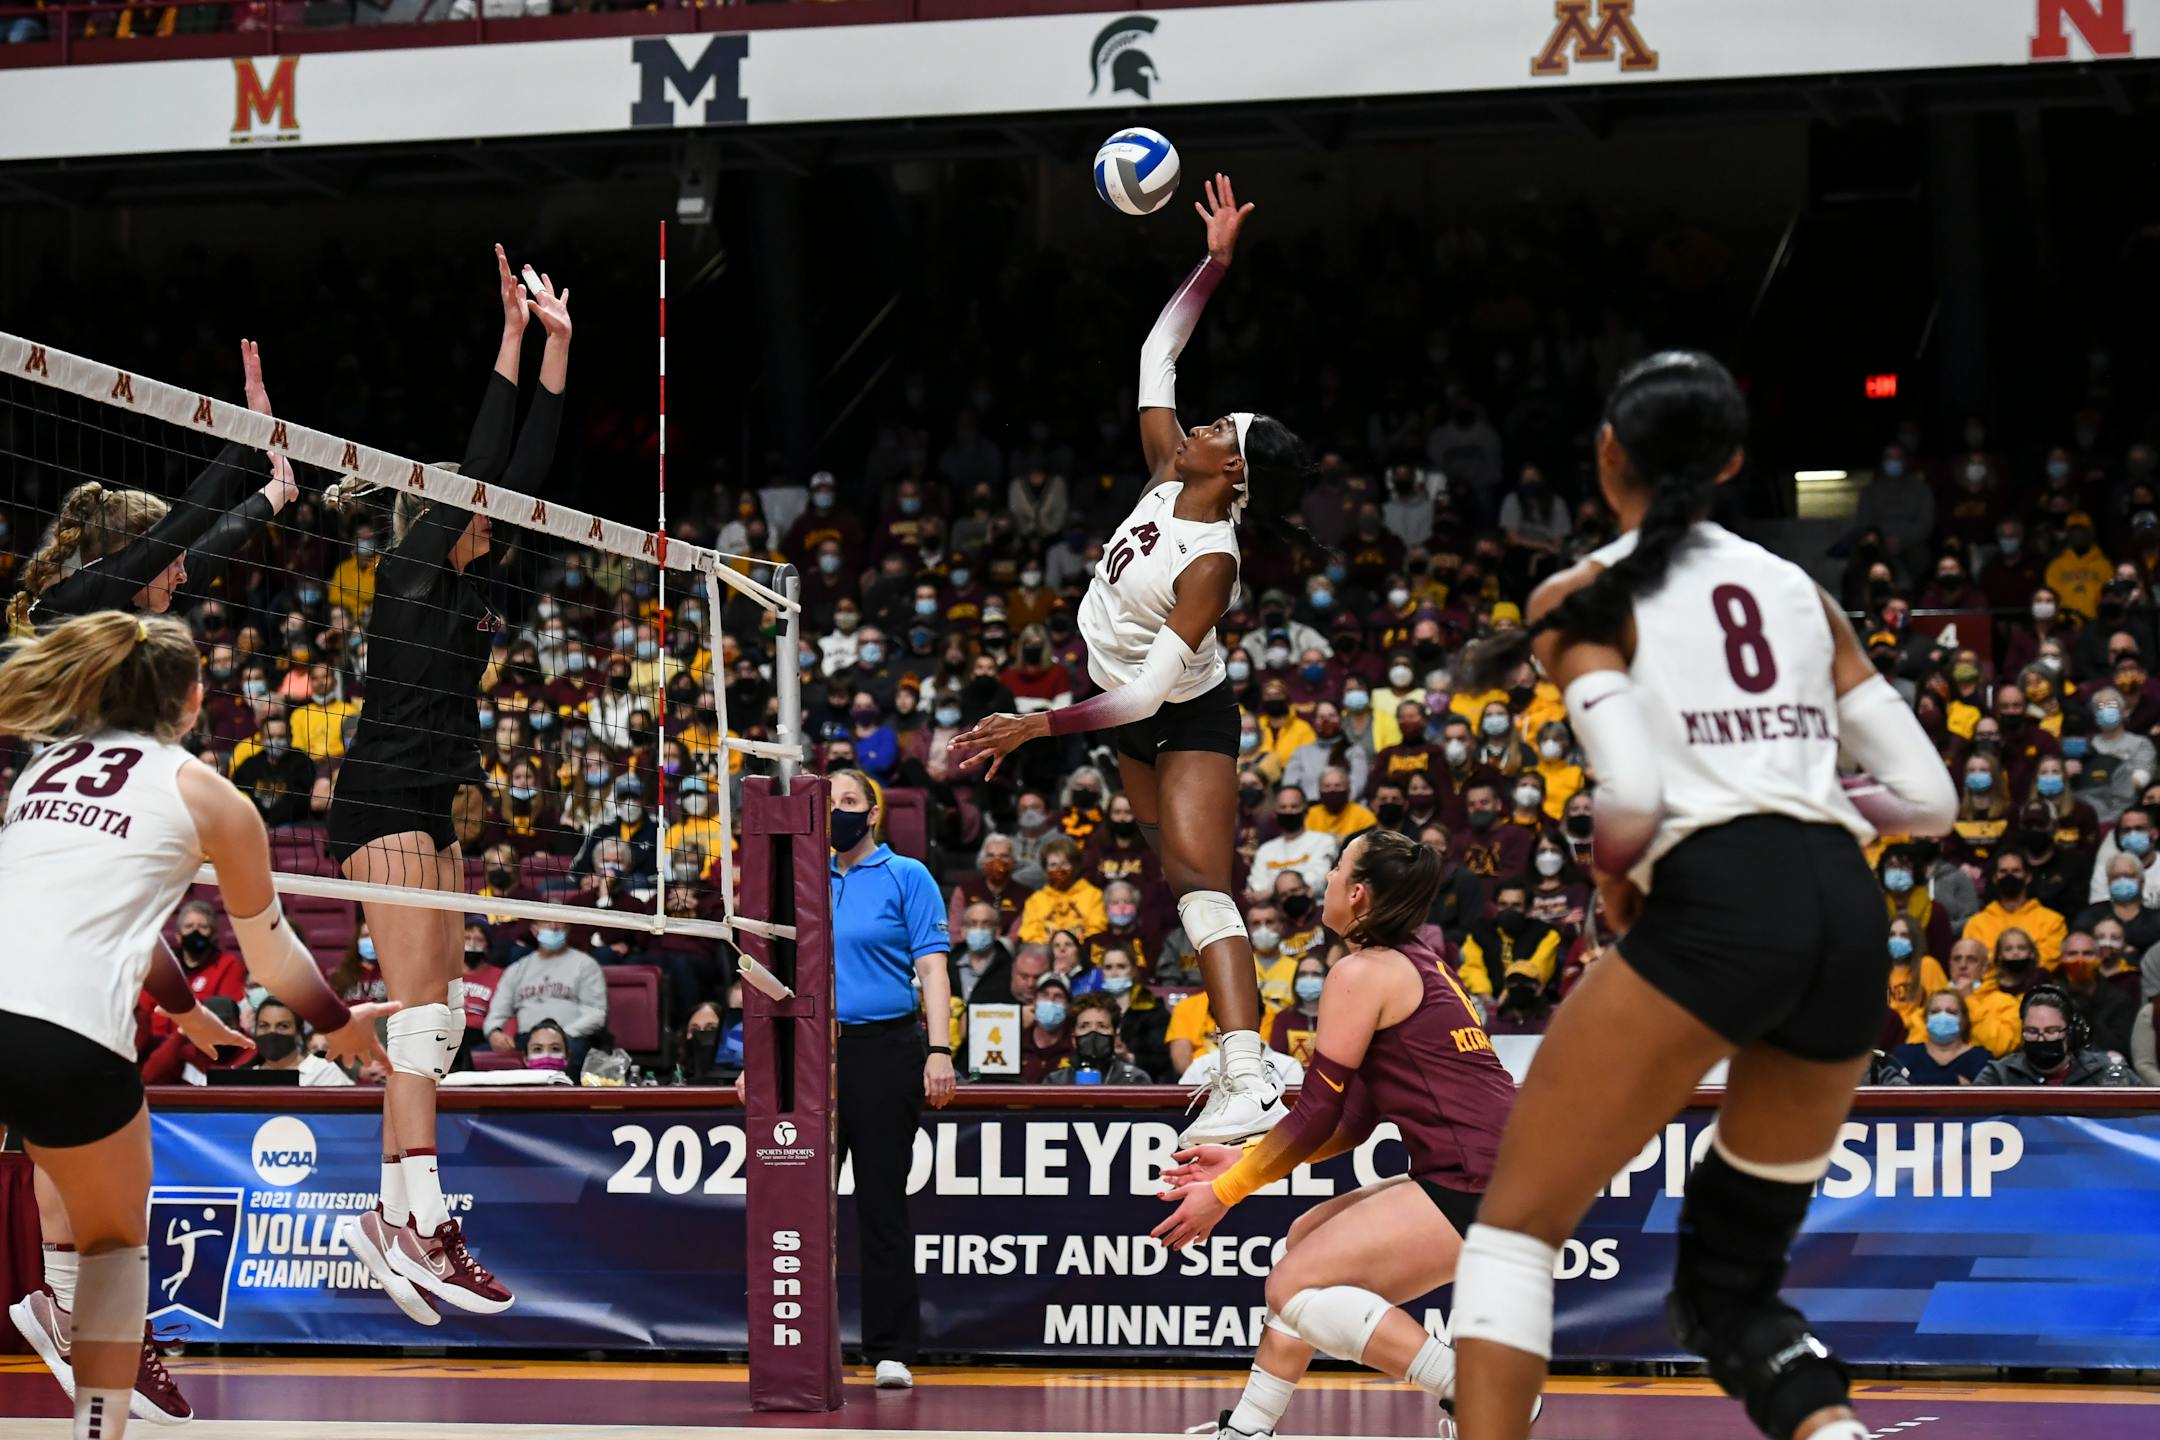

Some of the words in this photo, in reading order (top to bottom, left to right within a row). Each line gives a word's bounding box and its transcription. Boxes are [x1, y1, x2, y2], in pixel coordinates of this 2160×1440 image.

[1531, 0, 1658, 76] M
[231, 57, 301, 131] M
[630, 34, 750, 126] M
[1106, 537, 1135, 585] 10
[1712, 583, 1778, 694] 8
[1936, 623, 1960, 649] 4
[27, 741, 143, 798] 23
[988, 1026, 1003, 1045] 4
[259, 1151, 313, 1168] NCAA
[607, 1125, 746, 1195] 202
[756, 1148, 783, 1157] SPORTS
[783, 1148, 815, 1157] IMPORTS
[250, 1192, 291, 1208] 2021
[295, 1192, 379, 1210] DIVISION
[914, 1234, 1048, 1275] FIRST
[1055, 1235, 1169, 1276] AND
